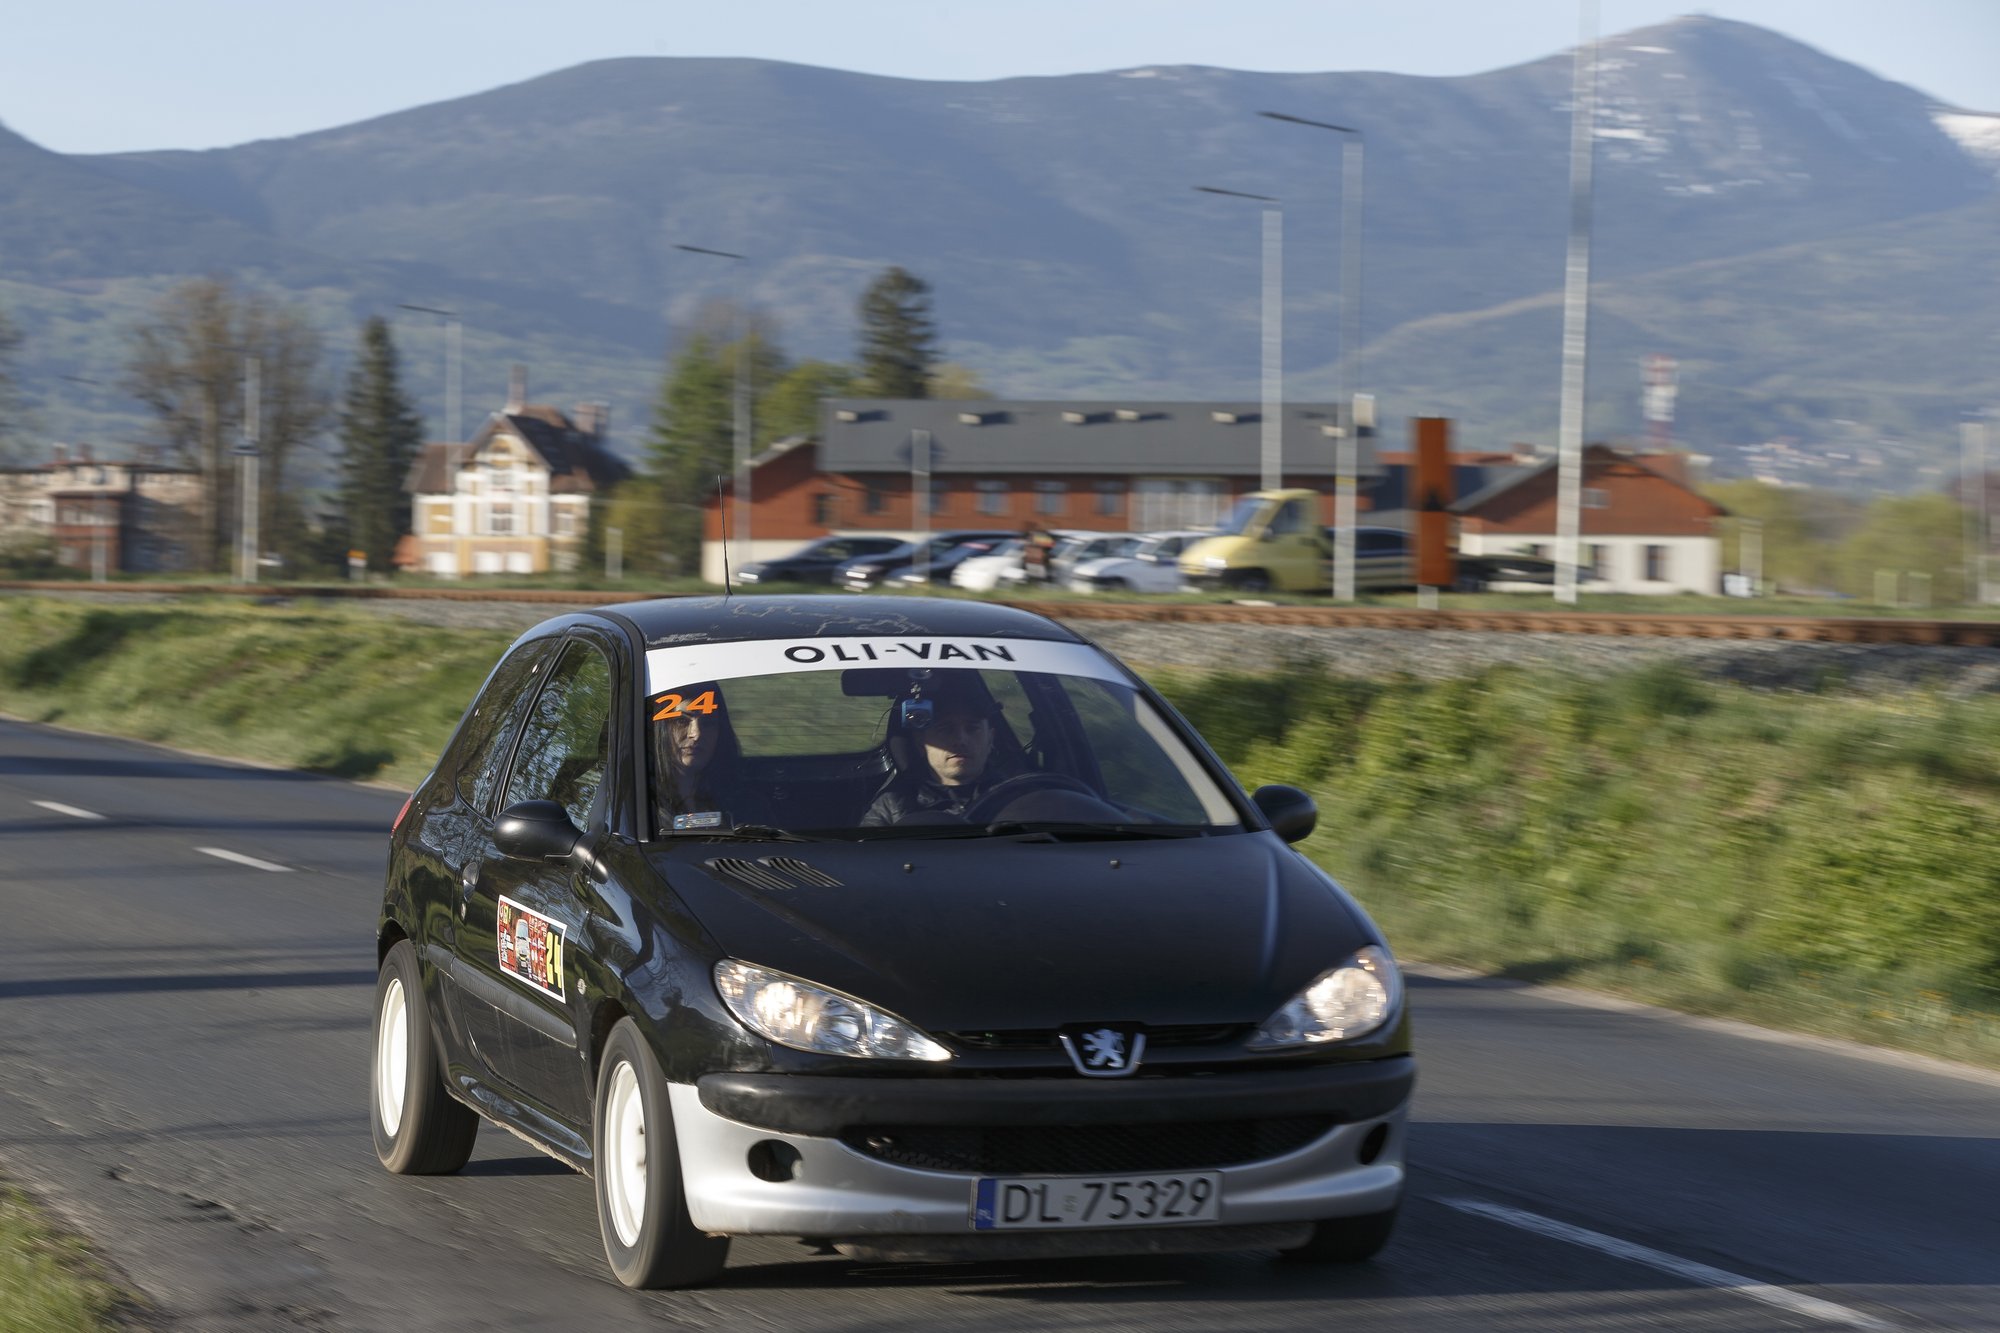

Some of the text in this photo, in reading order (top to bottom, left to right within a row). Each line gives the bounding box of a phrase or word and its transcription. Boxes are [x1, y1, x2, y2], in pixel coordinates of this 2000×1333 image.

[784, 643, 1016, 664] OLI-VAN
[652, 691, 718, 721] 24
[546, 931, 562, 989] 24
[1002, 1177, 1212, 1223] DL 75329
